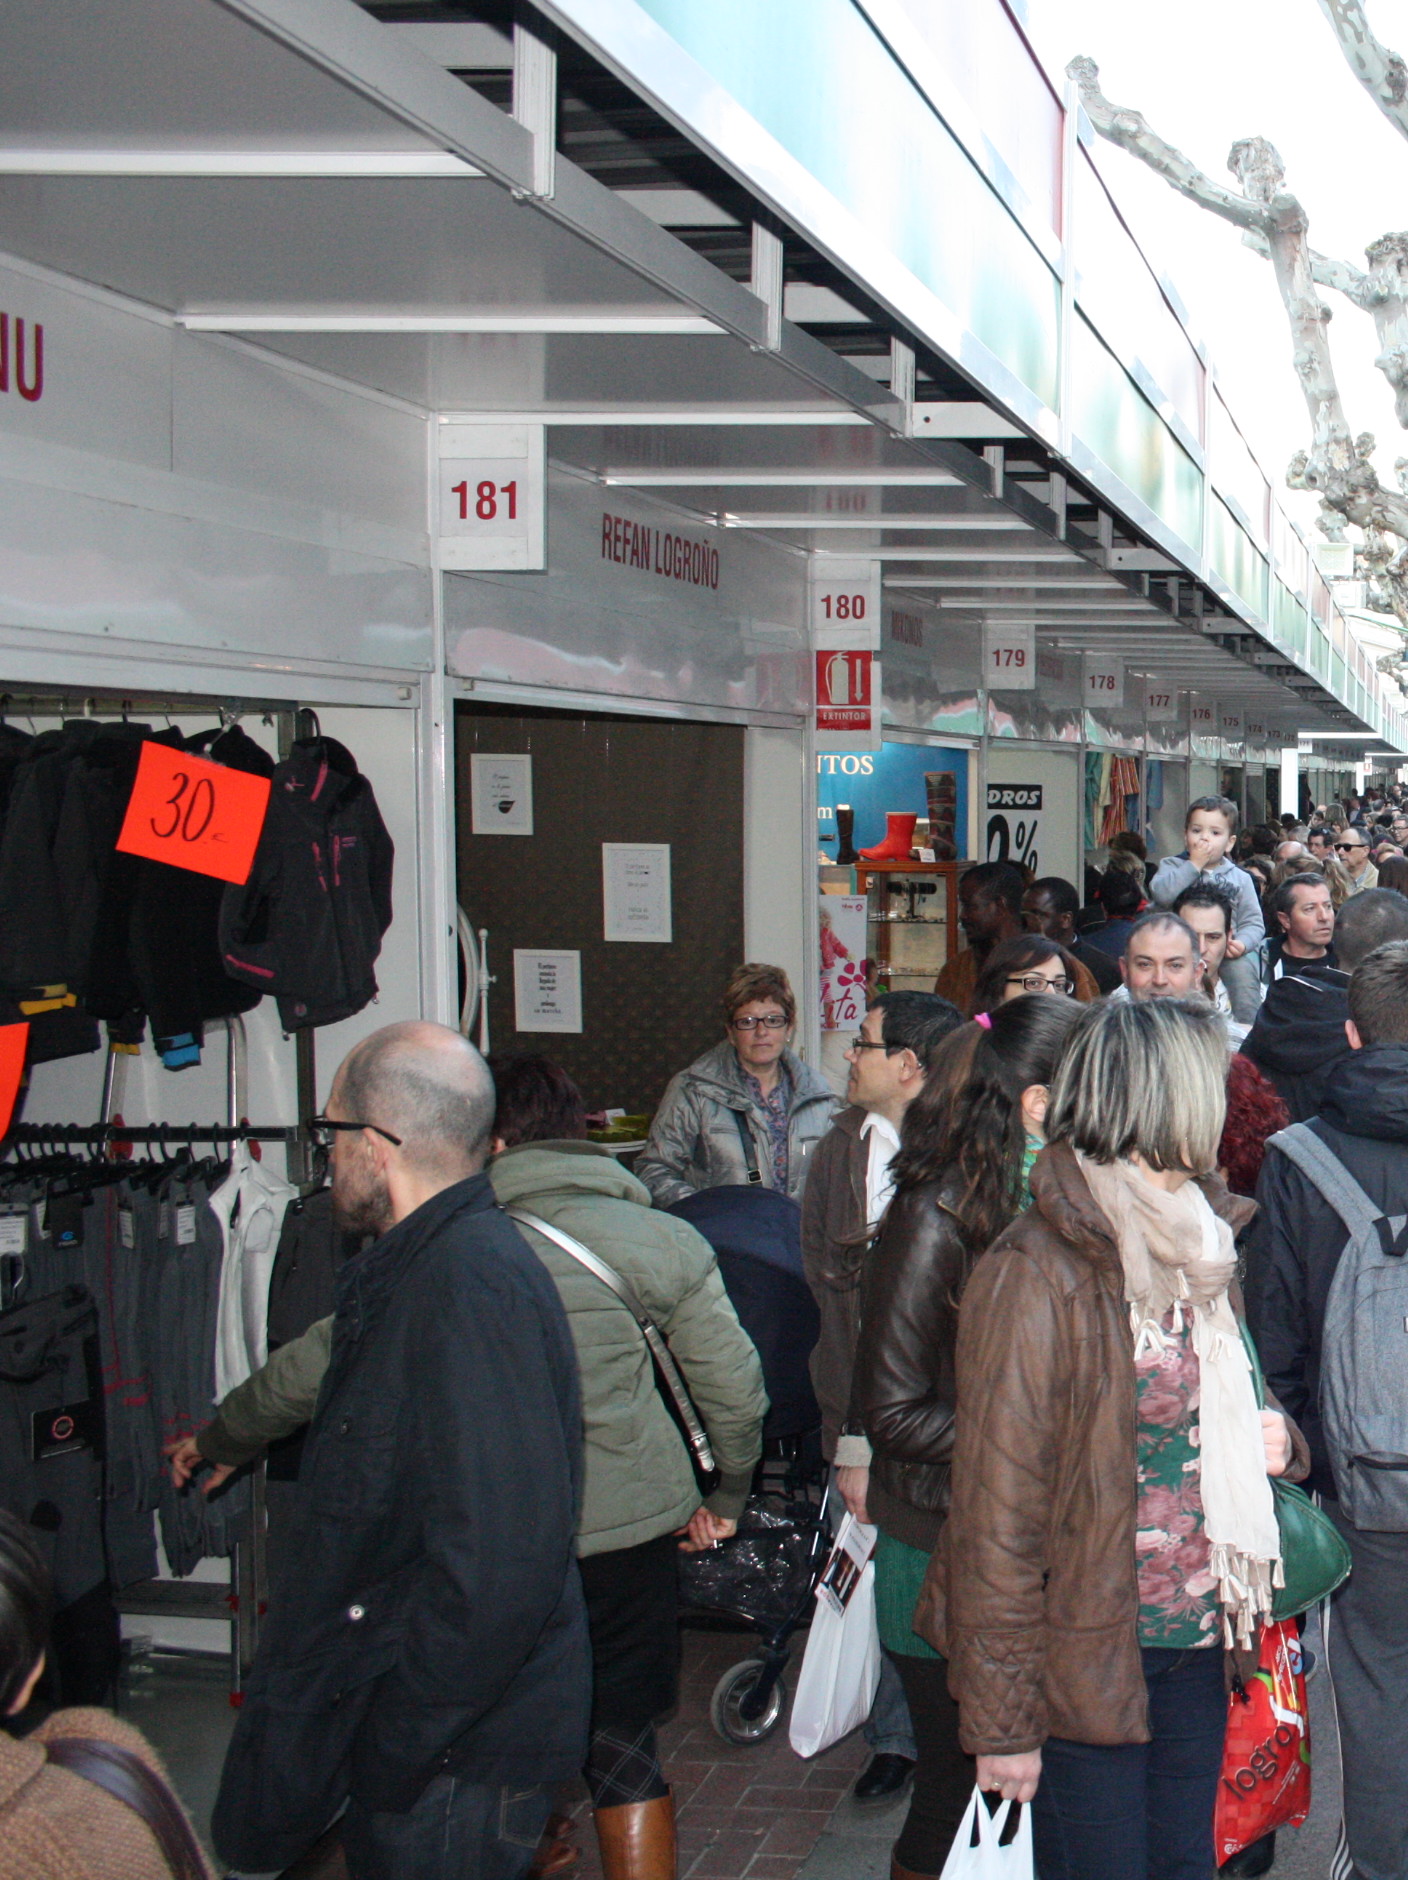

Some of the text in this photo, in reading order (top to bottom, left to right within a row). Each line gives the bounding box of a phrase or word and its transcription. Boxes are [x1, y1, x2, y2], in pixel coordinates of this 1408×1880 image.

[451, 480, 516, 520] 181
[602, 512, 719, 590] REFAN LOGROÑO
[820, 594, 866, 619] 180
[992, 649, 1025, 667] 179
[1089, 675, 1115, 690] 178
[1149, 695, 1170, 707] 177
[822, 711, 866, 720] EXTINTOR
[1192, 708, 1210, 719] 176
[1223, 717, 1239, 727] 175
